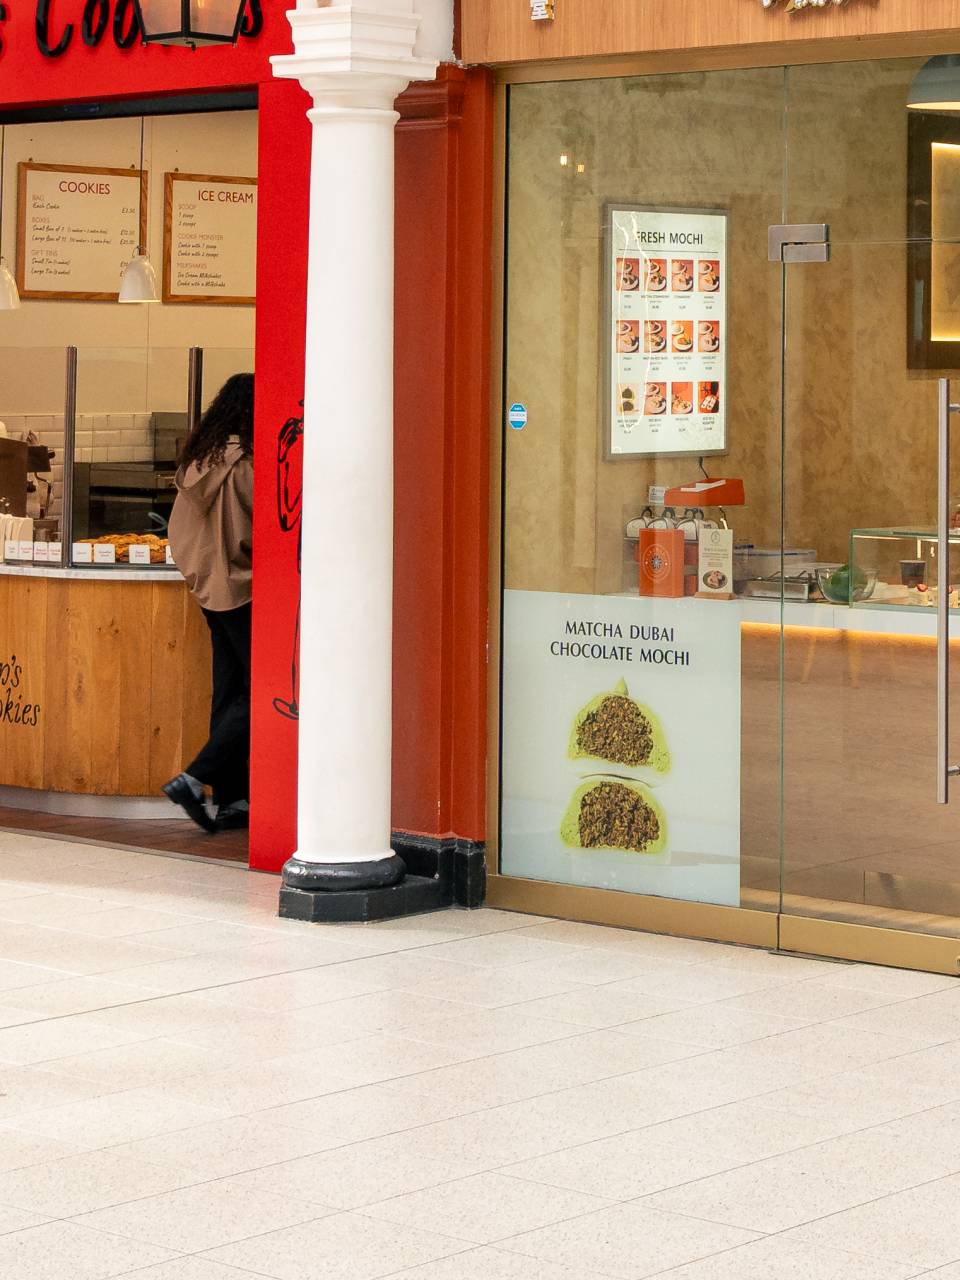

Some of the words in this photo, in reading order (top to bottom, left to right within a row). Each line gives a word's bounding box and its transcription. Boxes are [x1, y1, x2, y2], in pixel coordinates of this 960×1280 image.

[59, 181, 110, 195] COOKIES
[198, 190, 215, 201] ICE
[218, 191, 254, 203] CREAM
[670, 232, 703, 244] MOCHI
[565, 620, 623, 639] MATCHA
[630, 624, 674, 642] DUBAI
[550, 641, 633, 662] CHOCOLATE
[639, 648, 690, 666] MOCHI
